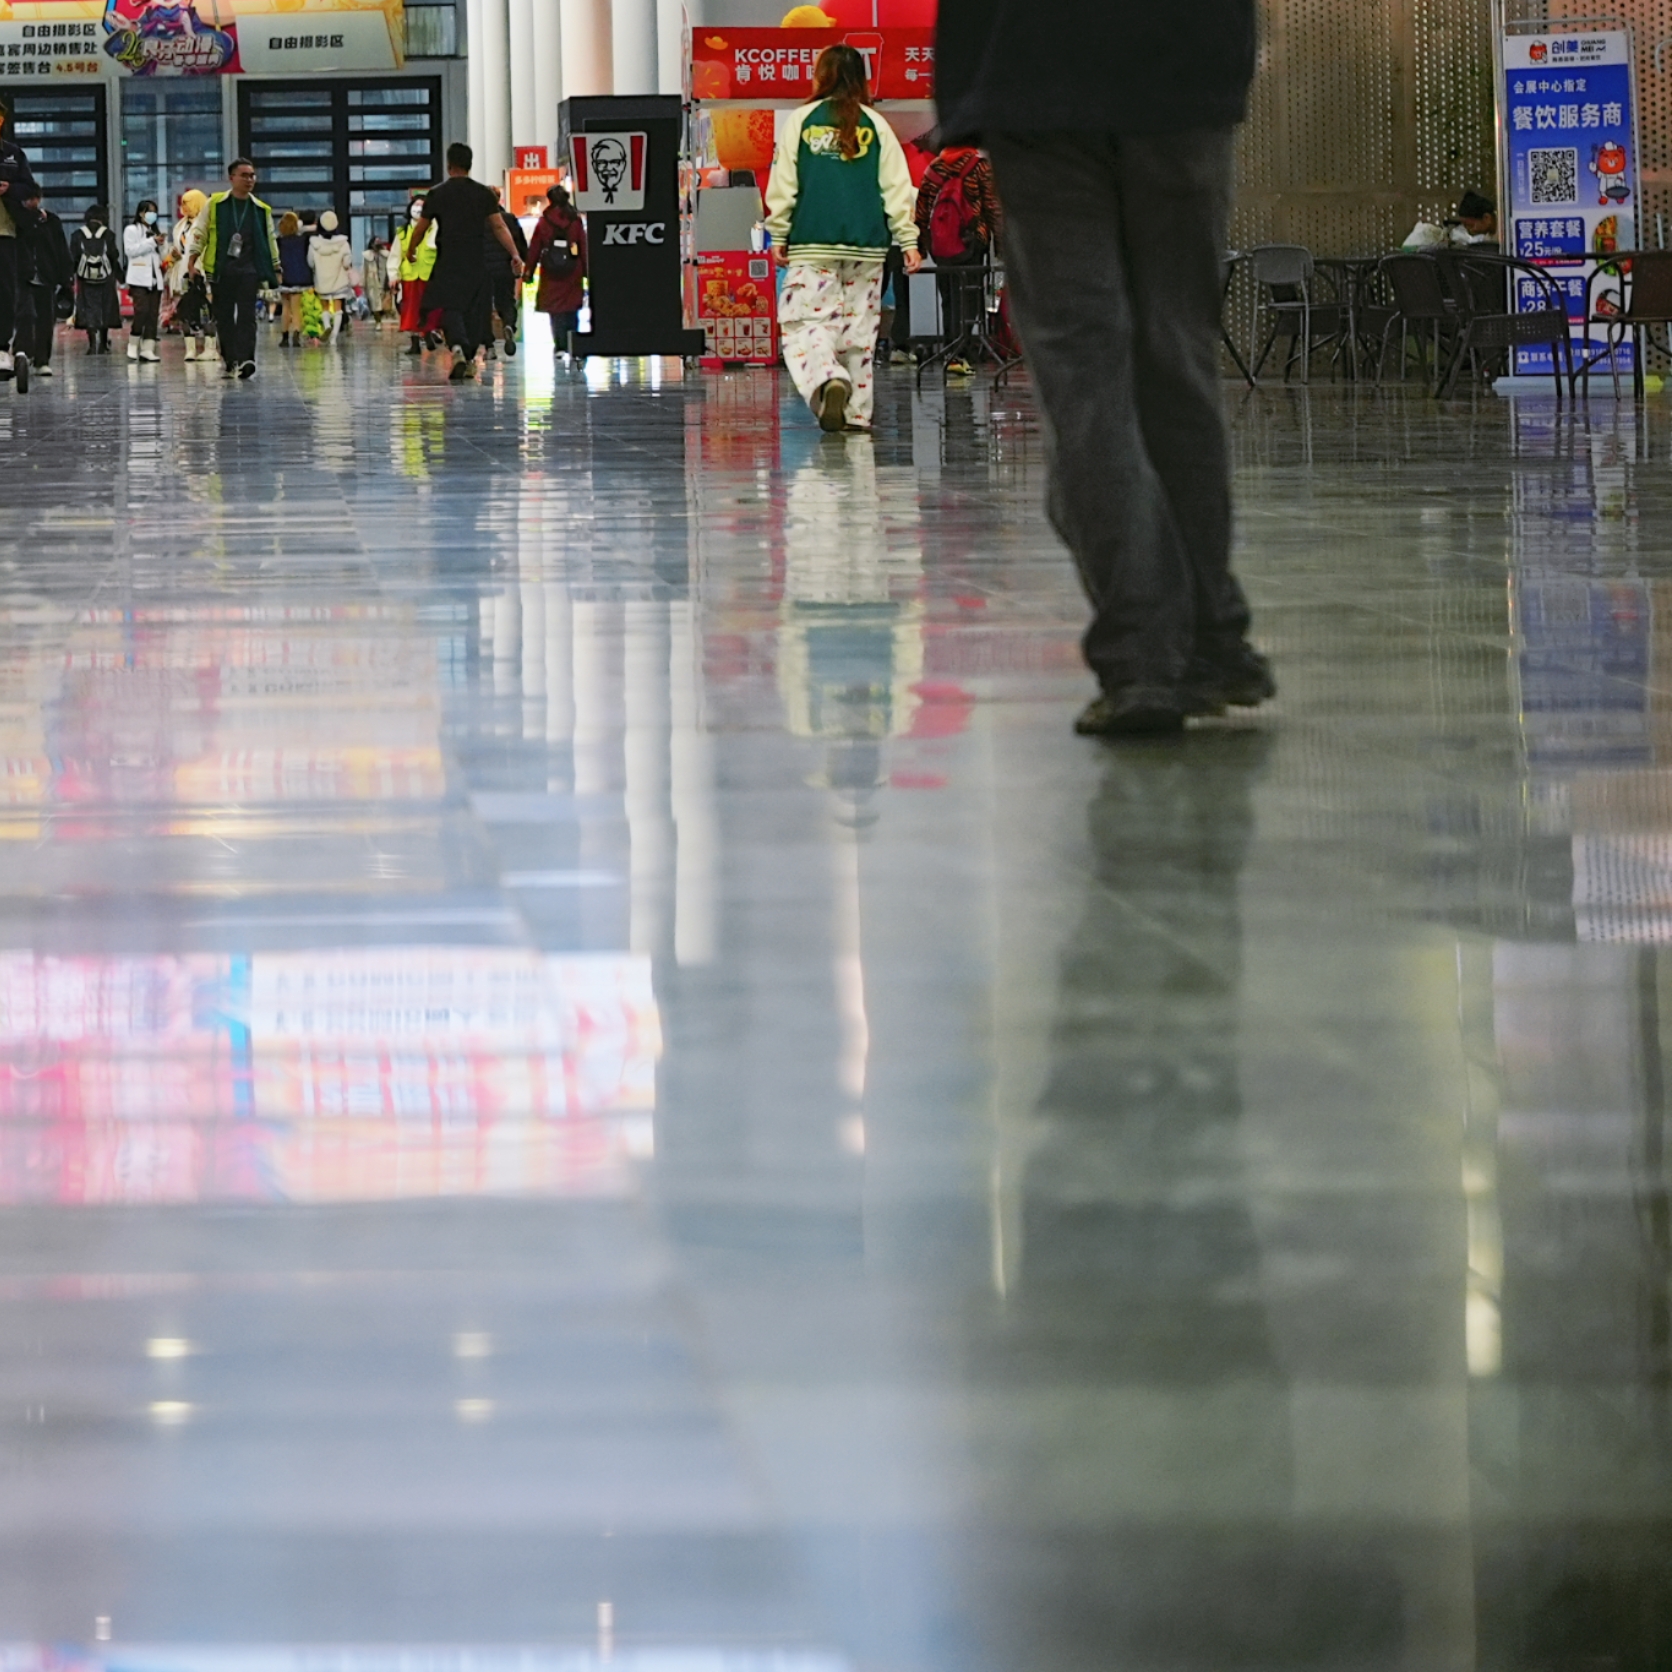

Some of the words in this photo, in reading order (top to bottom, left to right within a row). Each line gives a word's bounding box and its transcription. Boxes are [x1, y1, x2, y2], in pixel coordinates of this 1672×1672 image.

[21, 23, 97, 38] 自由摄影区
[268, 34, 345, 50] 自由摄影区
[1513, 78, 1587, 95] 会展中心指定
[1512, 101, 1623, 131] 餐饮服务商
[602, 221, 666, 246] KFC
[1518, 219, 1582, 240] 营养套餐
